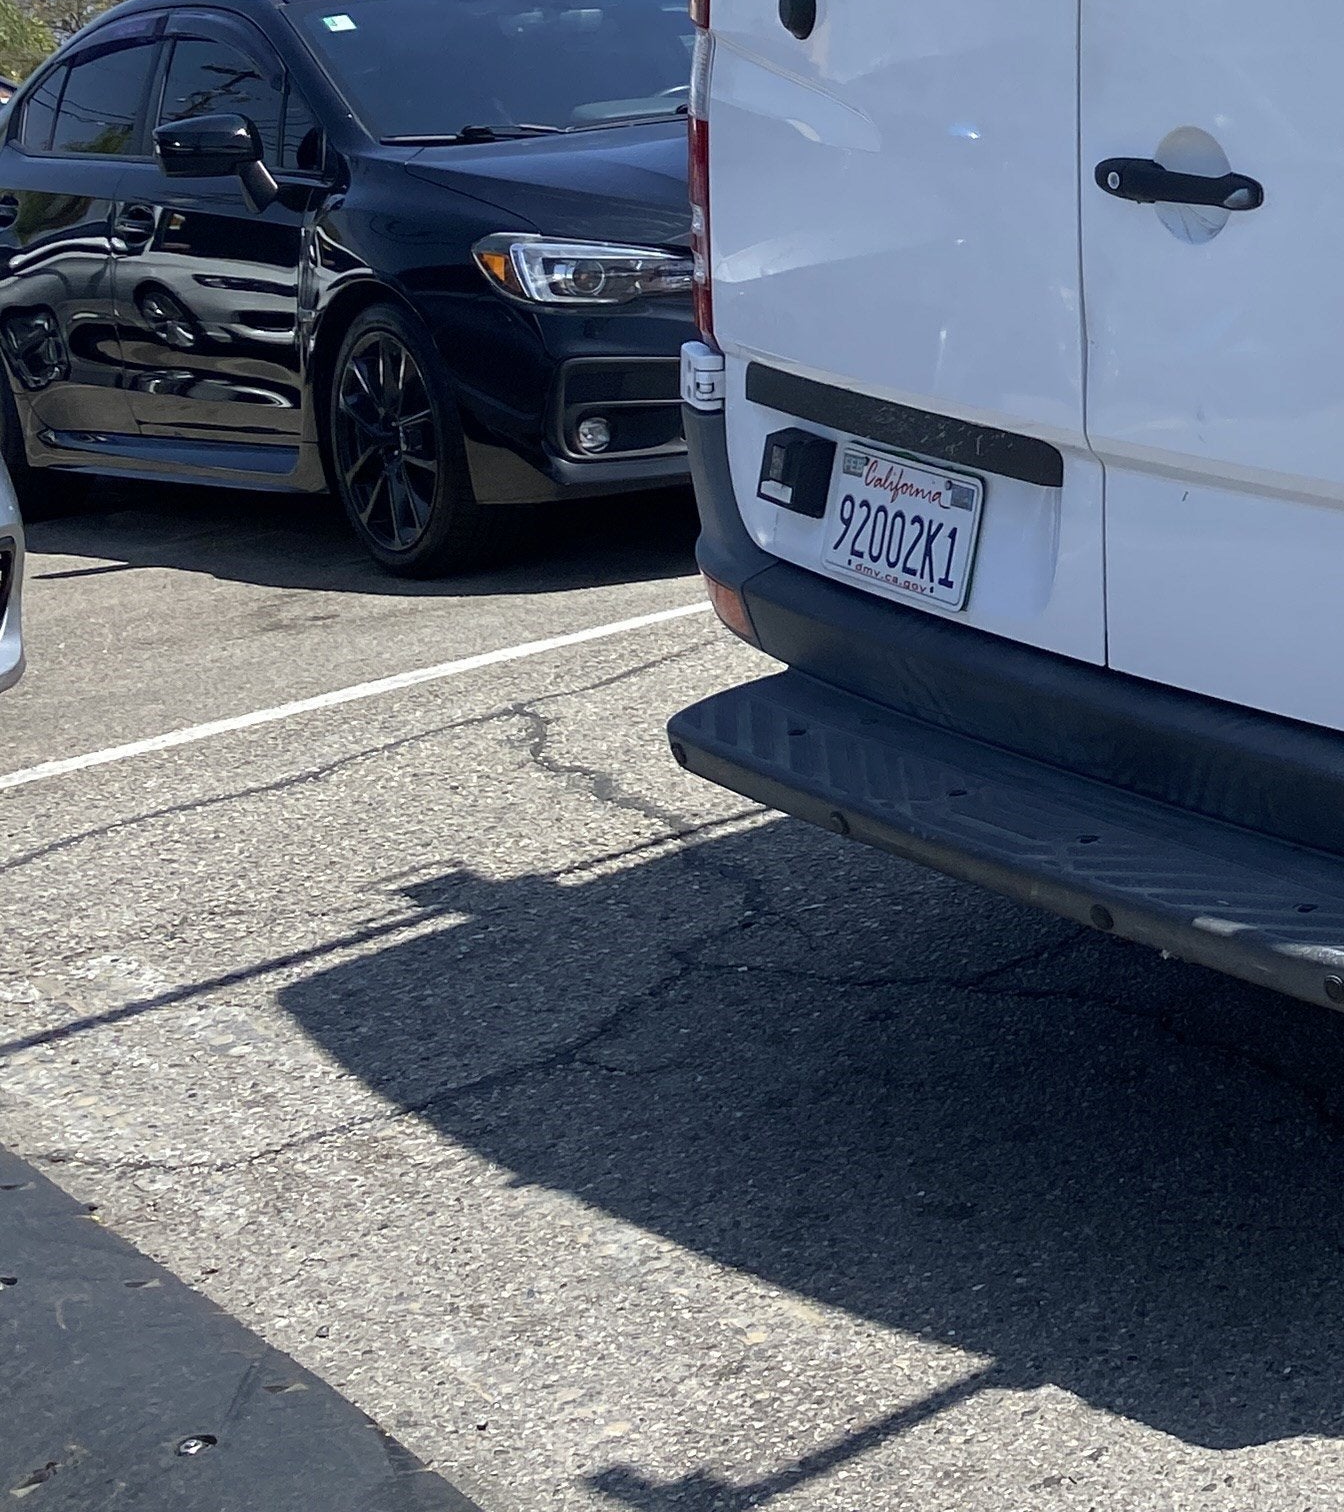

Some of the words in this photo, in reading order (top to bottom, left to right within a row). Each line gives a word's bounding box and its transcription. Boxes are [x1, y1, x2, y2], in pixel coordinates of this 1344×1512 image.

[864, 460, 951, 509] California
[833, 493, 958, 589] 92002K1
[855, 563, 927, 593] dmv.ca.gov
